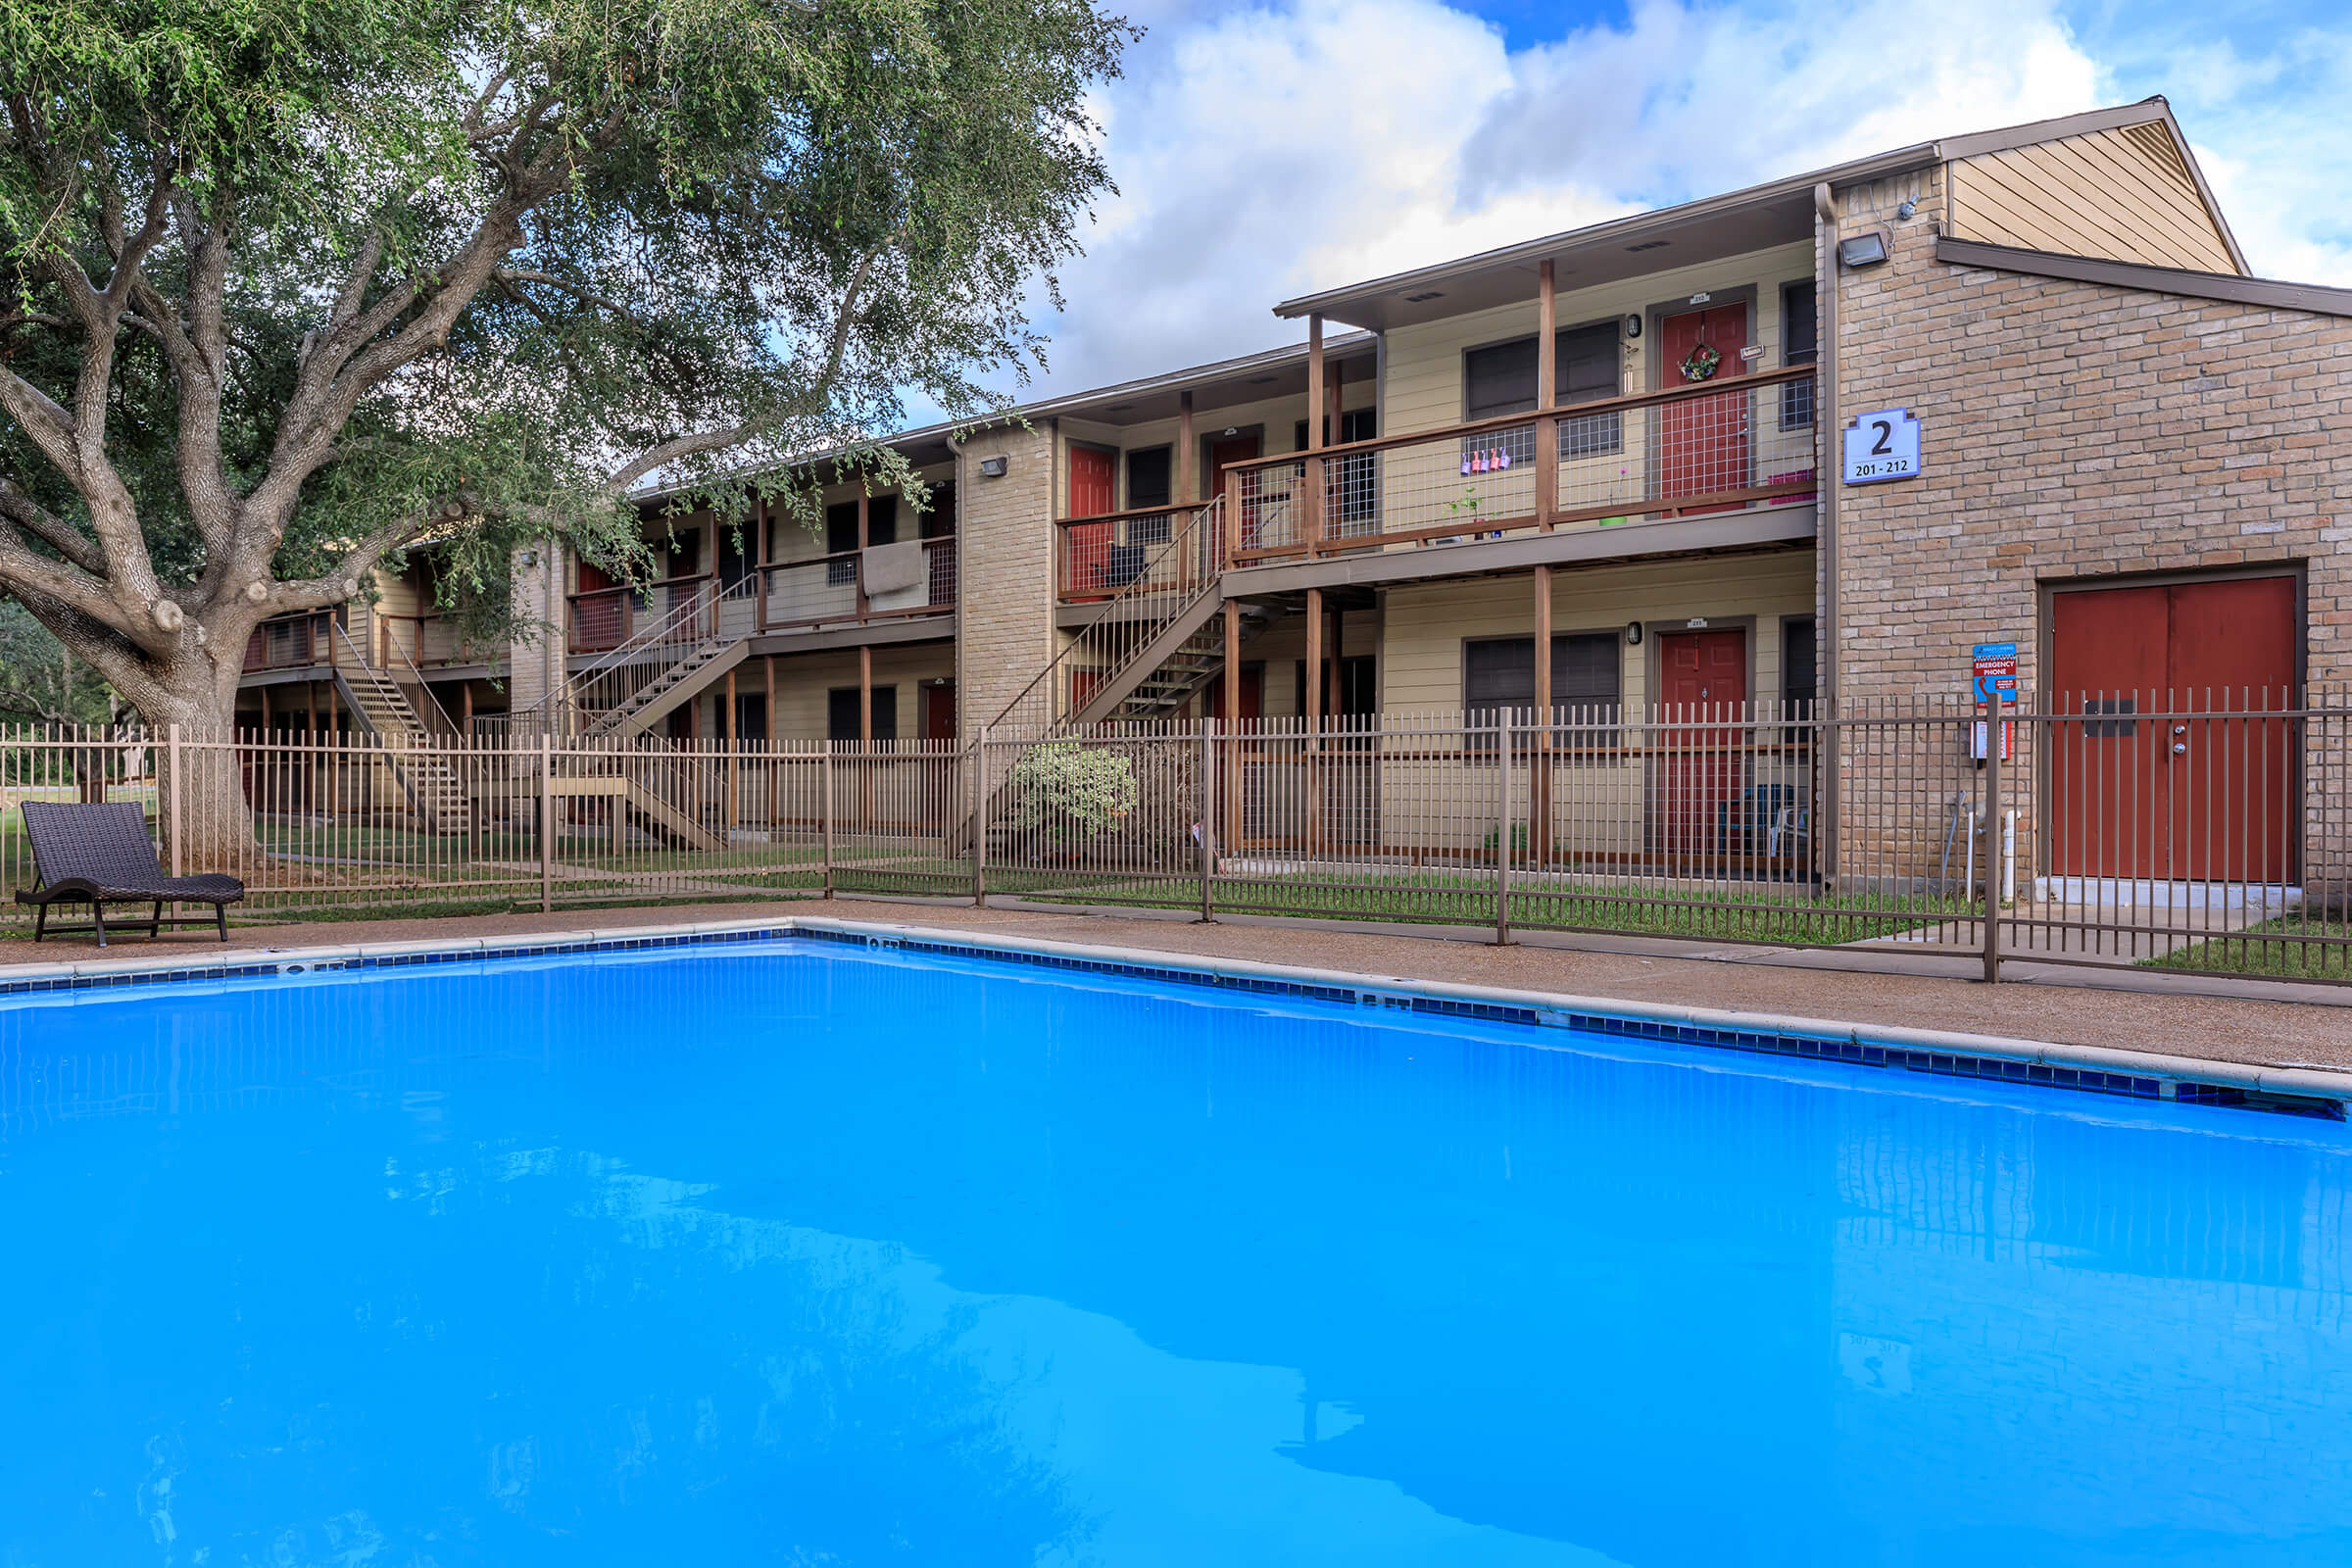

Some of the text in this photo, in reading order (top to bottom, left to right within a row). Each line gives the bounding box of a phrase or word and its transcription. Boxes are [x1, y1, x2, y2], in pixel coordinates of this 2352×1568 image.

[1871, 420, 1892, 456] 2
[1856, 464, 1876, 476] 201
[1886, 460, 1908, 472] 212
[1976, 661, 2015, 669] EMERGENCY
